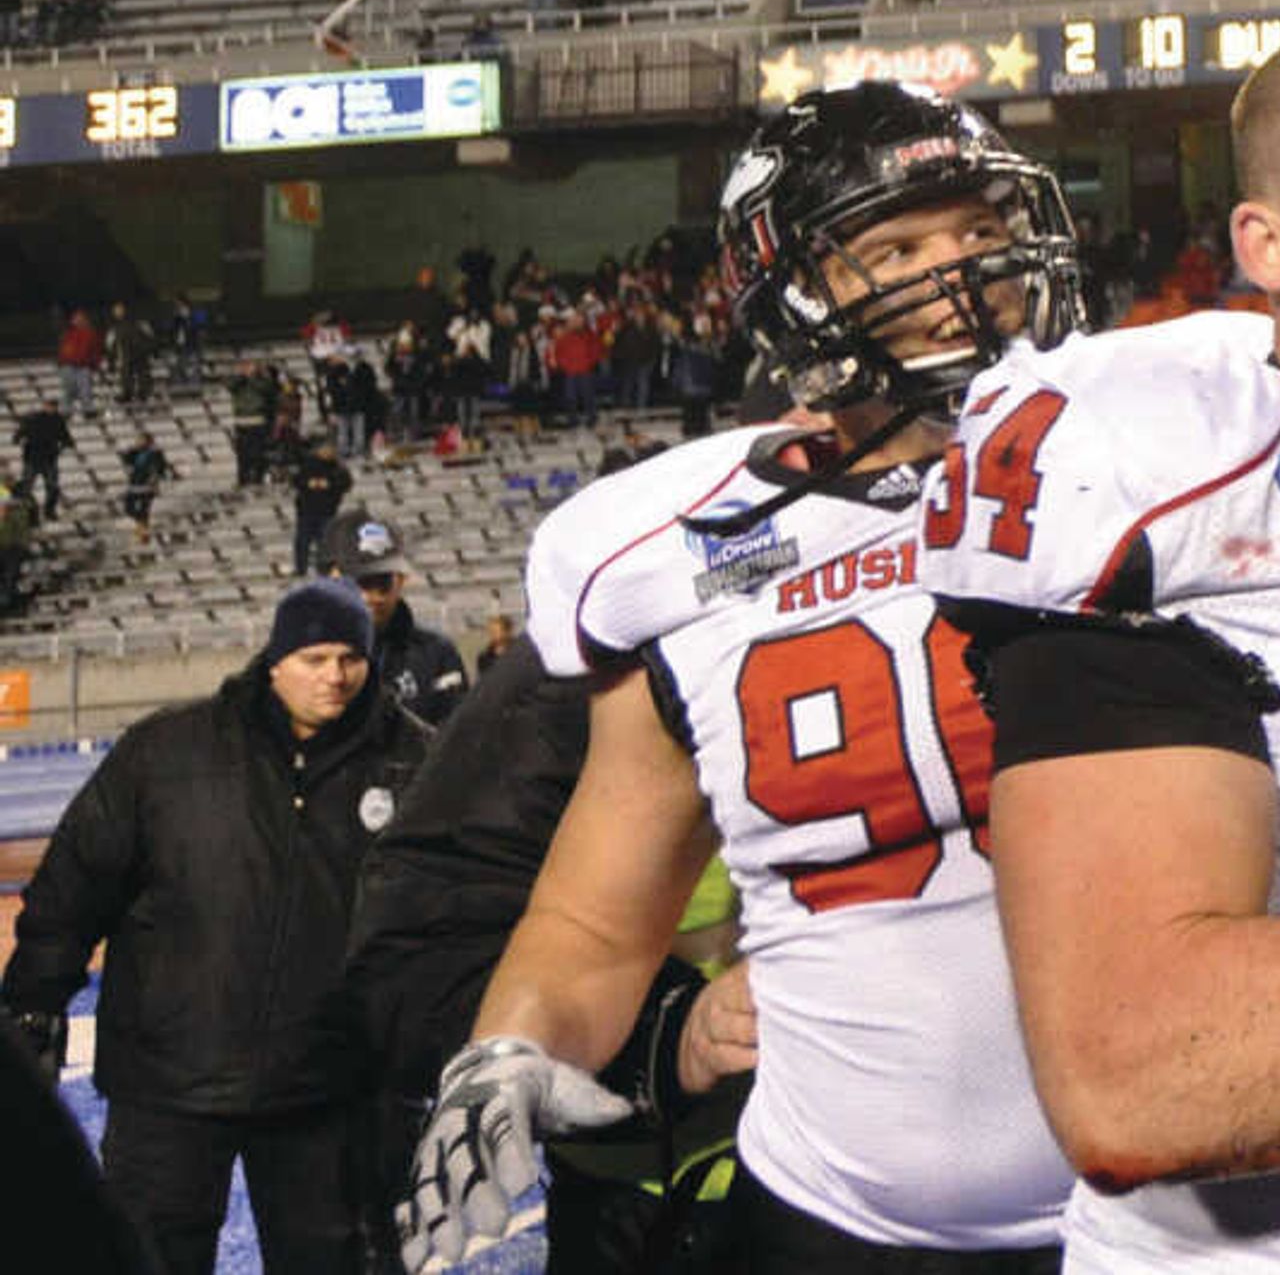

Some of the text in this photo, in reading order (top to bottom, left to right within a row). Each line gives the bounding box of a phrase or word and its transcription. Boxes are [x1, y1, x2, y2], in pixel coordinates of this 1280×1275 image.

[1064, 22, 1097, 74] 2
[1139, 13, 1185, 70] 10
[86, 85, 178, 142] 362
[924, 388, 1069, 561] 54
